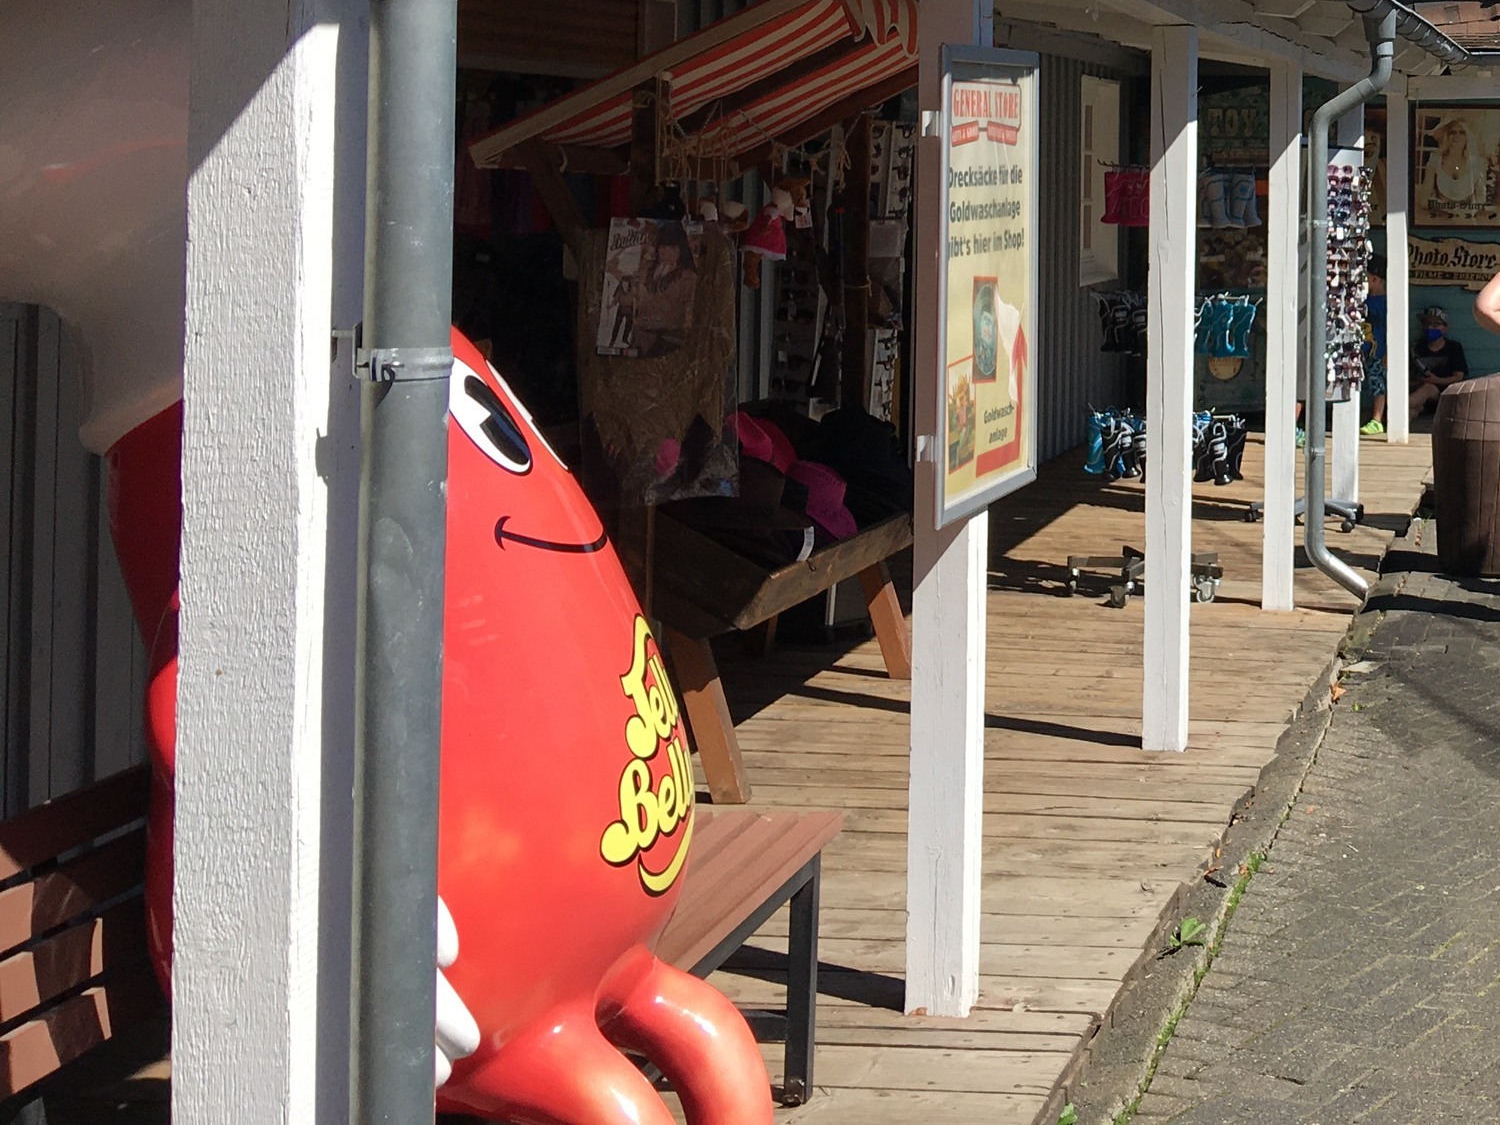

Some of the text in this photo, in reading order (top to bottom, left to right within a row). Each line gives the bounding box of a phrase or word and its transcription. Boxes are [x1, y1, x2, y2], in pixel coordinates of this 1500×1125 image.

[953, 88, 1019, 119] GENERAL STORE
[1010, 164, 1023, 184] die
[949, 197, 1021, 223] Goldwaschanlage
[948, 227, 1025, 258] ibt's hier im Shop!
[1447, 245, 1499, 269] Store
[620, 613, 679, 759] Jell
[599, 738, 694, 866] Bell
